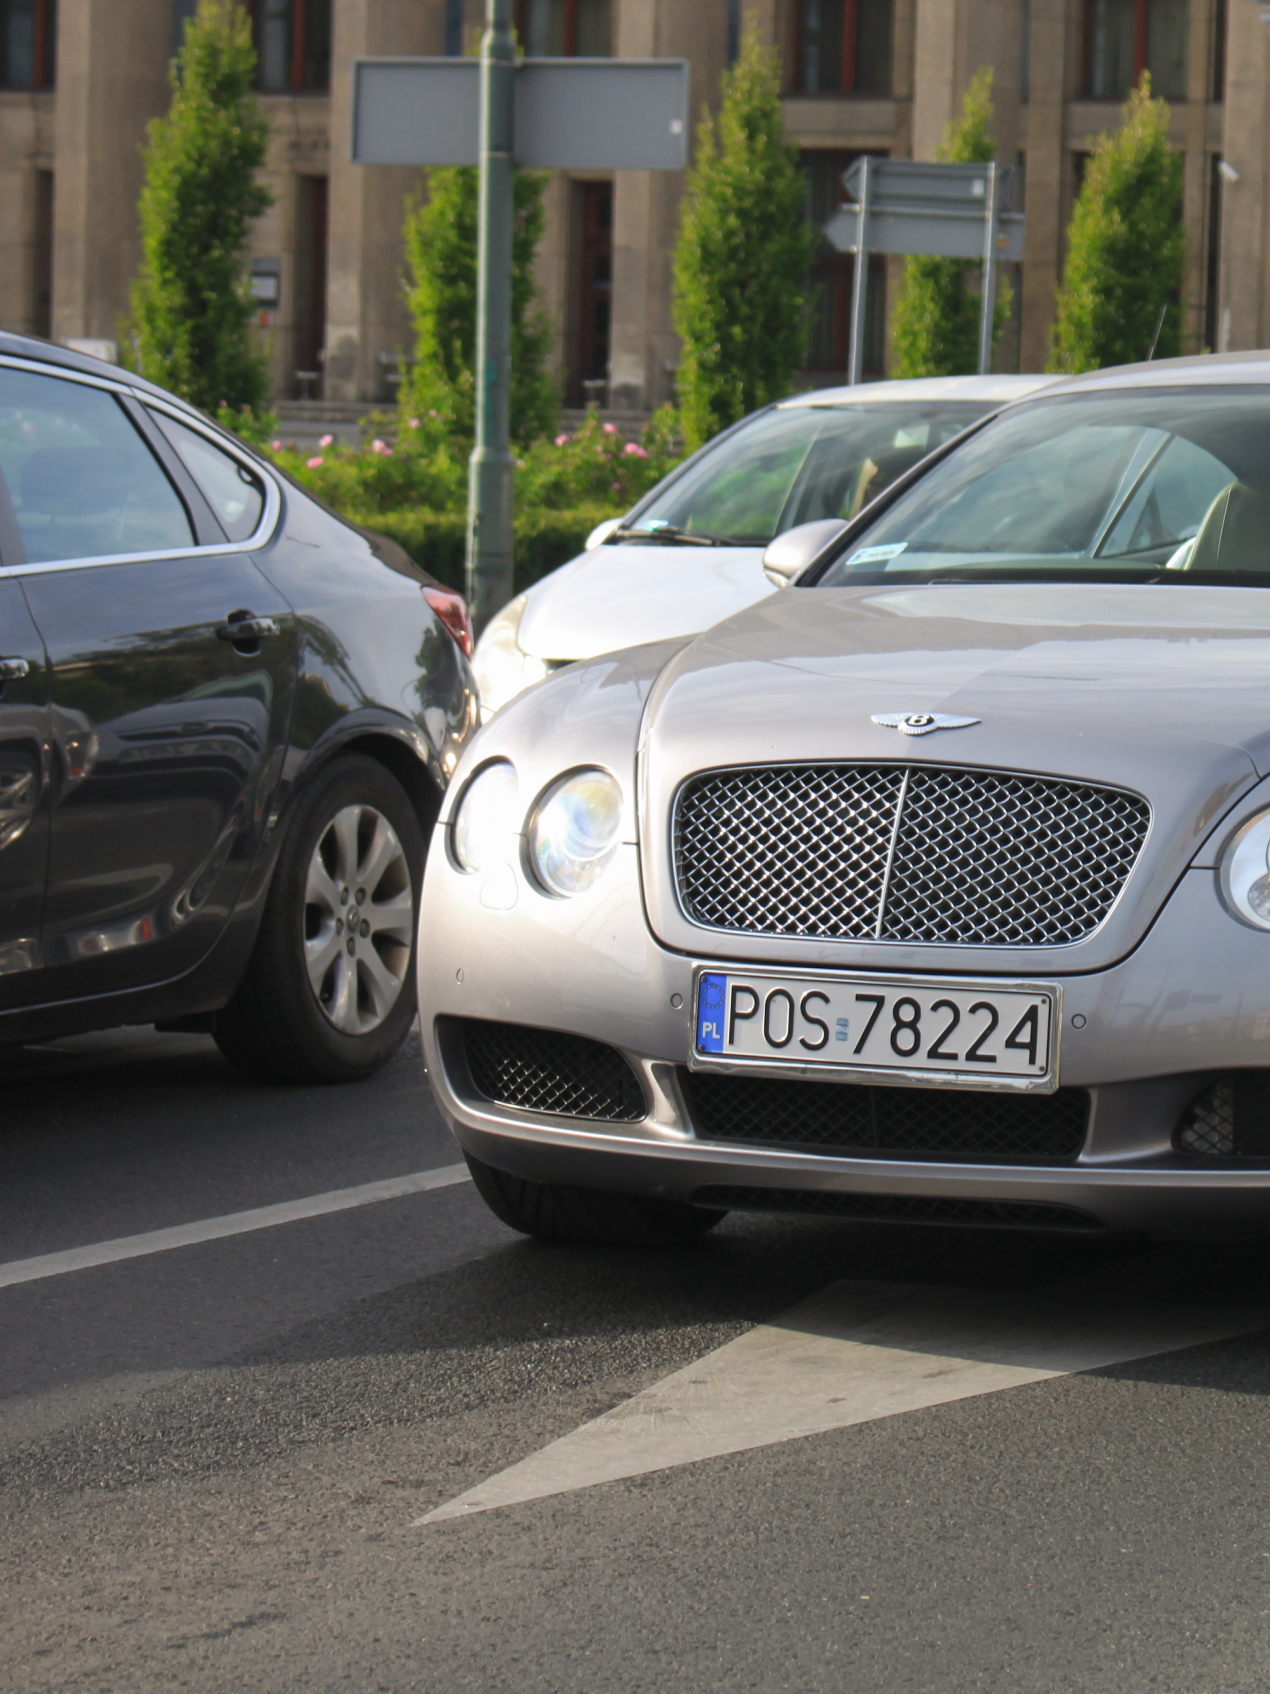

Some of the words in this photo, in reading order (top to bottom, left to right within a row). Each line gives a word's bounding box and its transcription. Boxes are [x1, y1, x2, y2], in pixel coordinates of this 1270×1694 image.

[702, 1022, 721, 1039] PL
[727, 984, 831, 1053] POS
[852, 993, 1040, 1066] 78224
